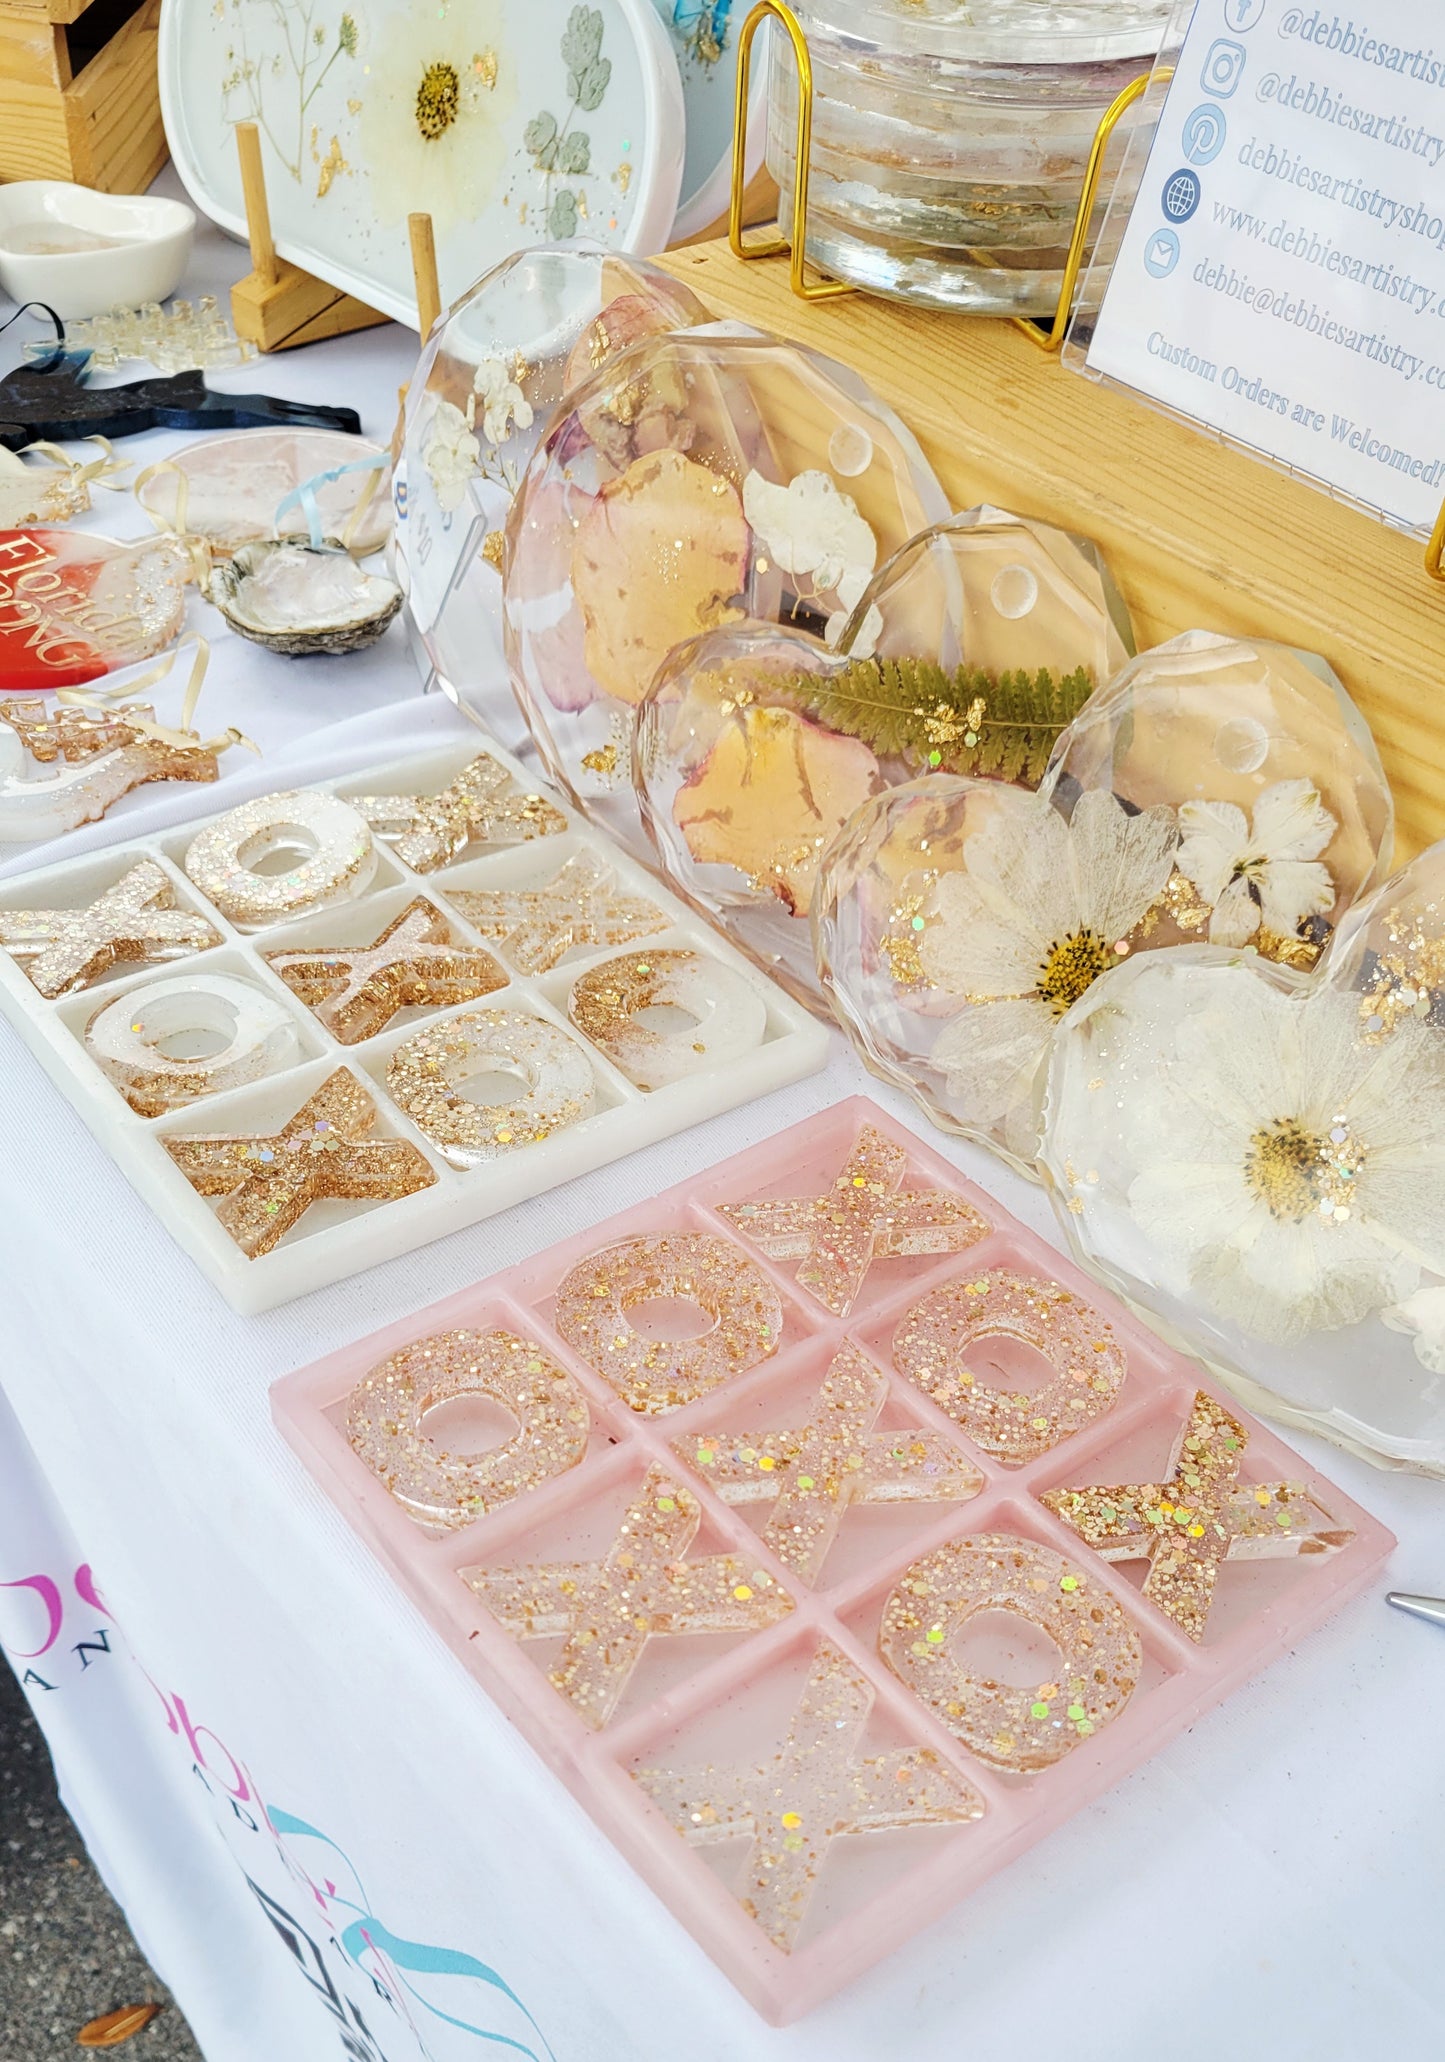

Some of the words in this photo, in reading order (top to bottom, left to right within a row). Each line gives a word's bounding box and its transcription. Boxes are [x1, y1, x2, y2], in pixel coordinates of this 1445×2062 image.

[1256, 72, 1445, 167] @debbiesartistry
[1147, 331, 1218, 382] Custom
[1221, 366, 1290, 416] Orders
[1291, 403, 1326, 432] are
[1330, 414, 1445, 489] Welcomed!
